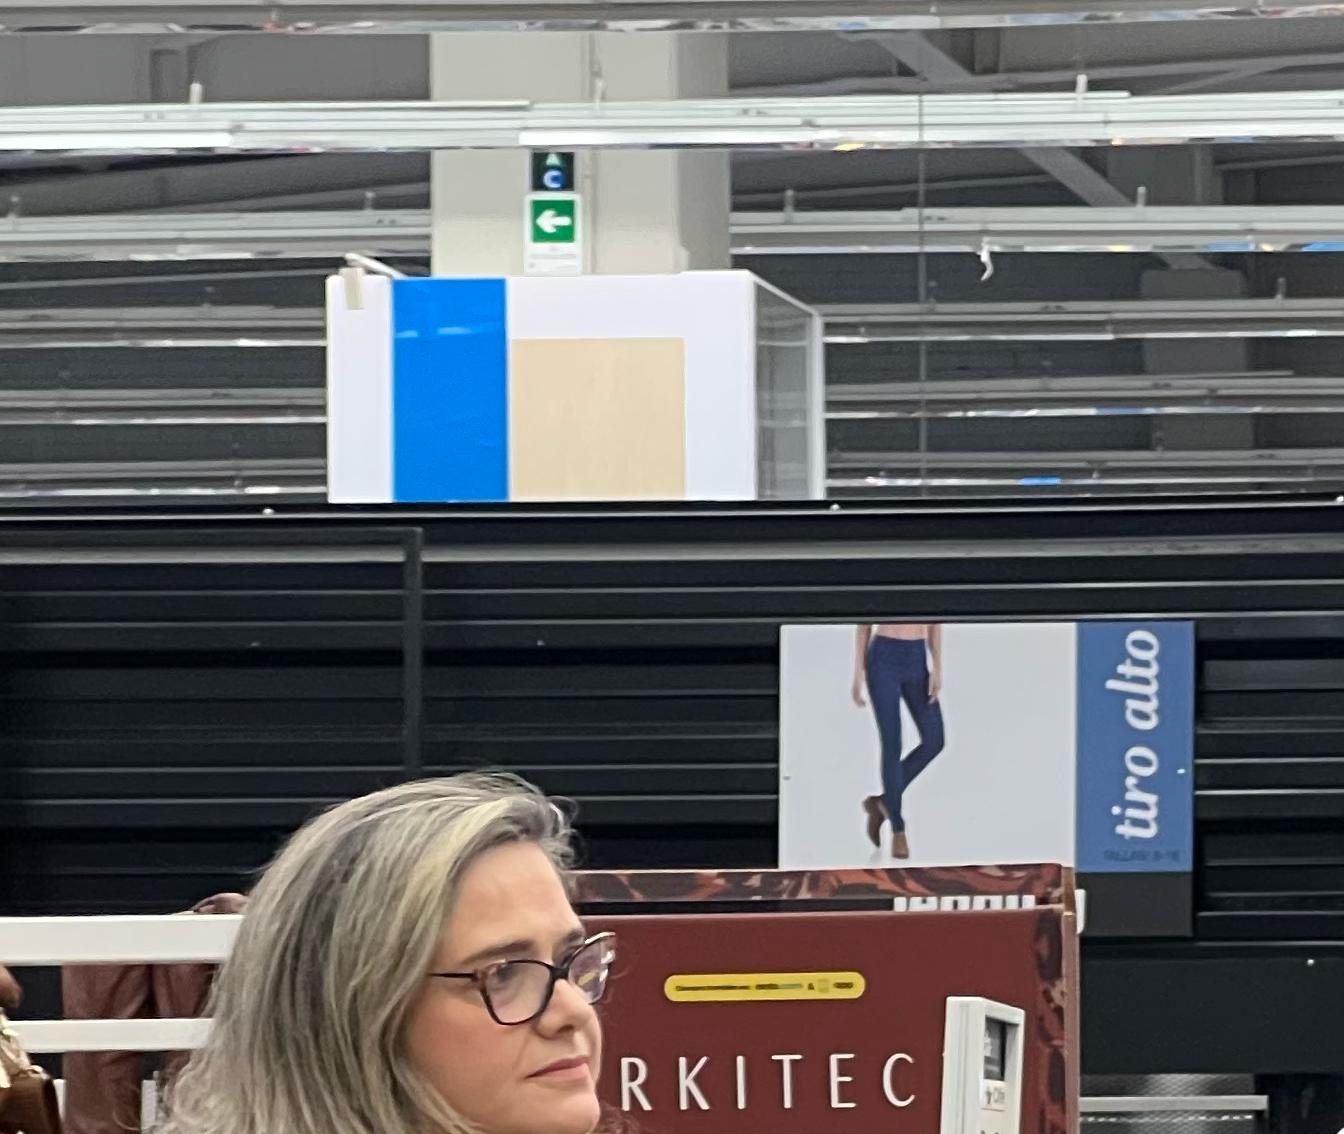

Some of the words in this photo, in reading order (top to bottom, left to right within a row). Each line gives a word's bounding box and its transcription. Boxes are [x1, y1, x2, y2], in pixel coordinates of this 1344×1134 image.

[1104, 629, 1160, 731] alto
[1111, 745, 1159, 839] tiro
[620, 1053, 916, 1112] RKITEC
